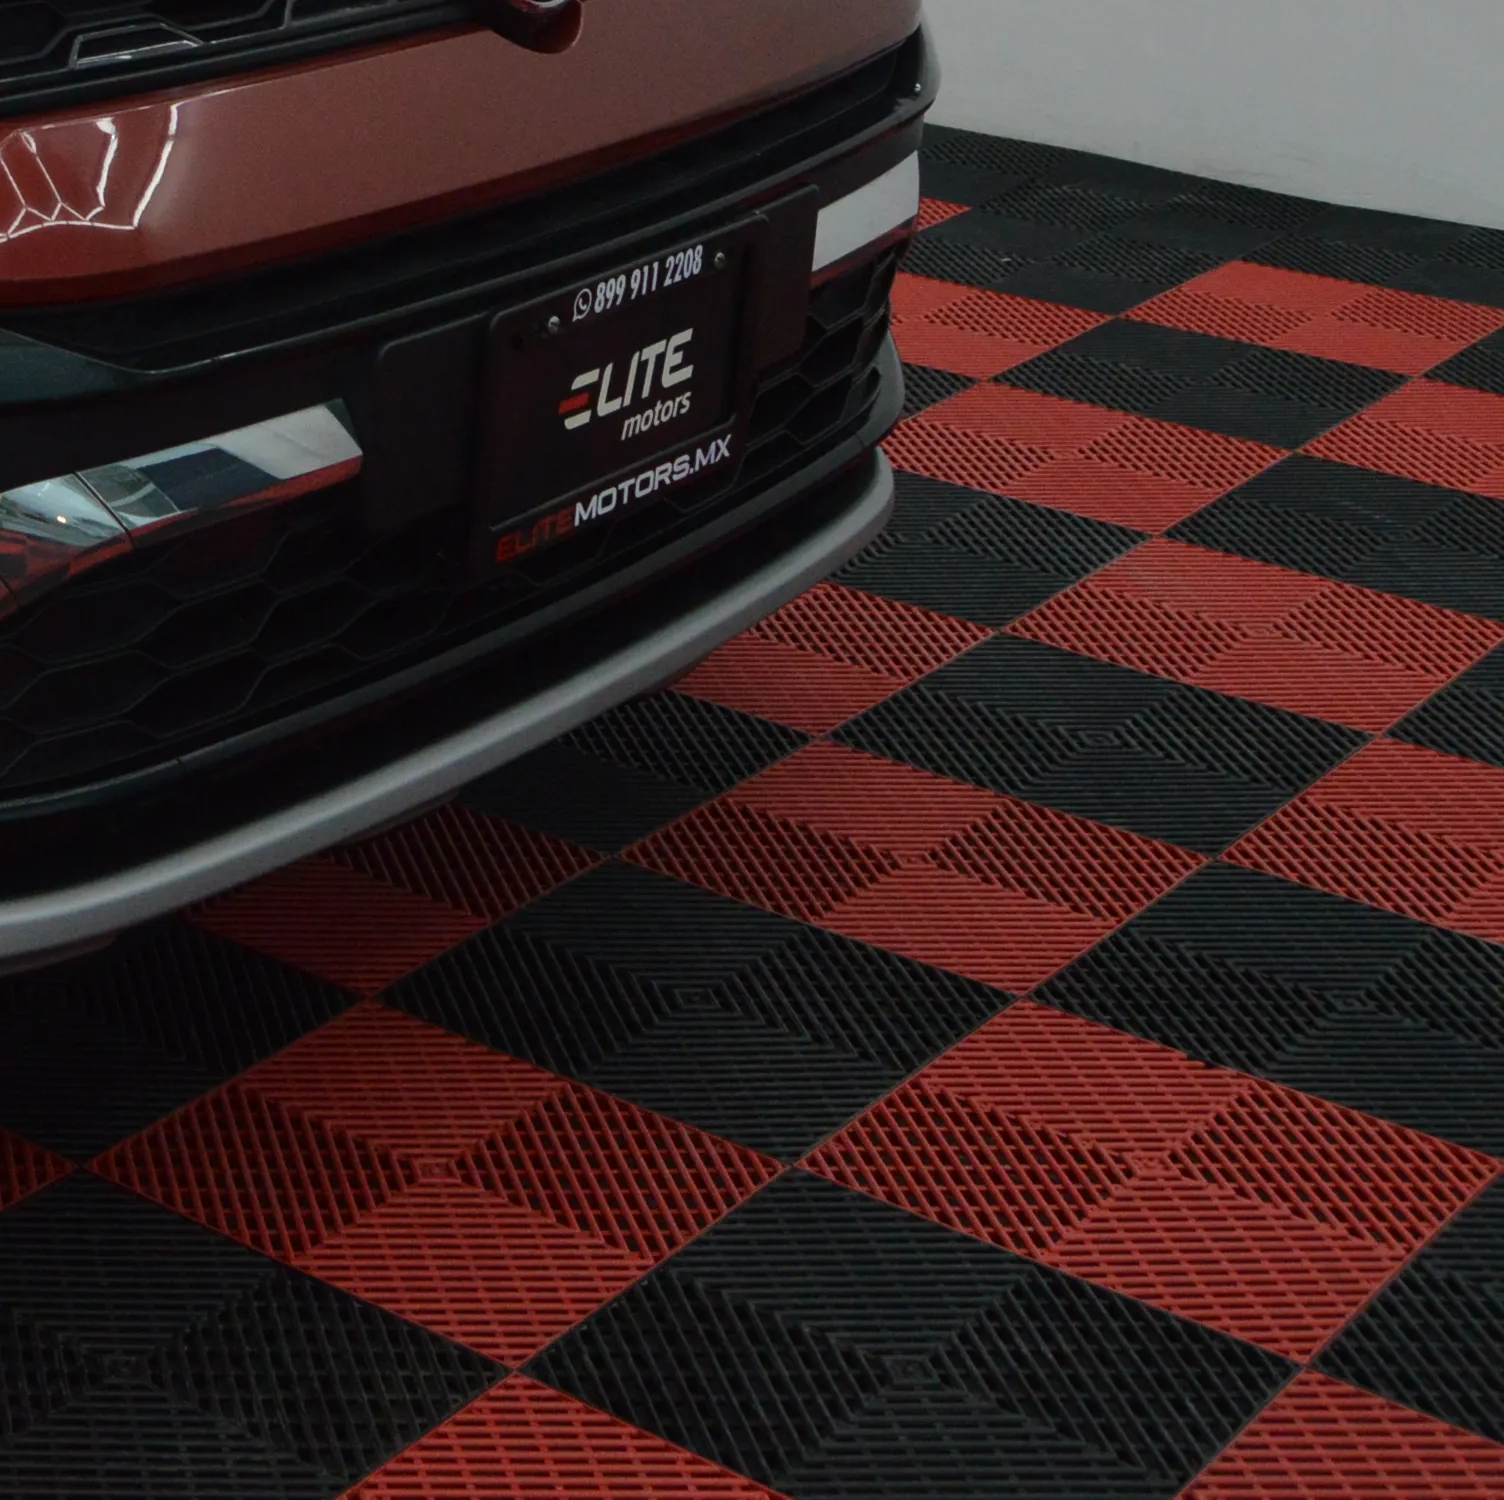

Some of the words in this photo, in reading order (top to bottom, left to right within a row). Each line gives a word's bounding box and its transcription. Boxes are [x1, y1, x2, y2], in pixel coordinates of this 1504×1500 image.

[594, 274, 626, 313] 899
[630, 261, 659, 299] 911
[663, 244, 703, 287] 2208
[558, 328, 694, 430] ELITE
[621, 391, 692, 441] motors
[497, 434, 732, 563] ELITEMOTORS.MX
